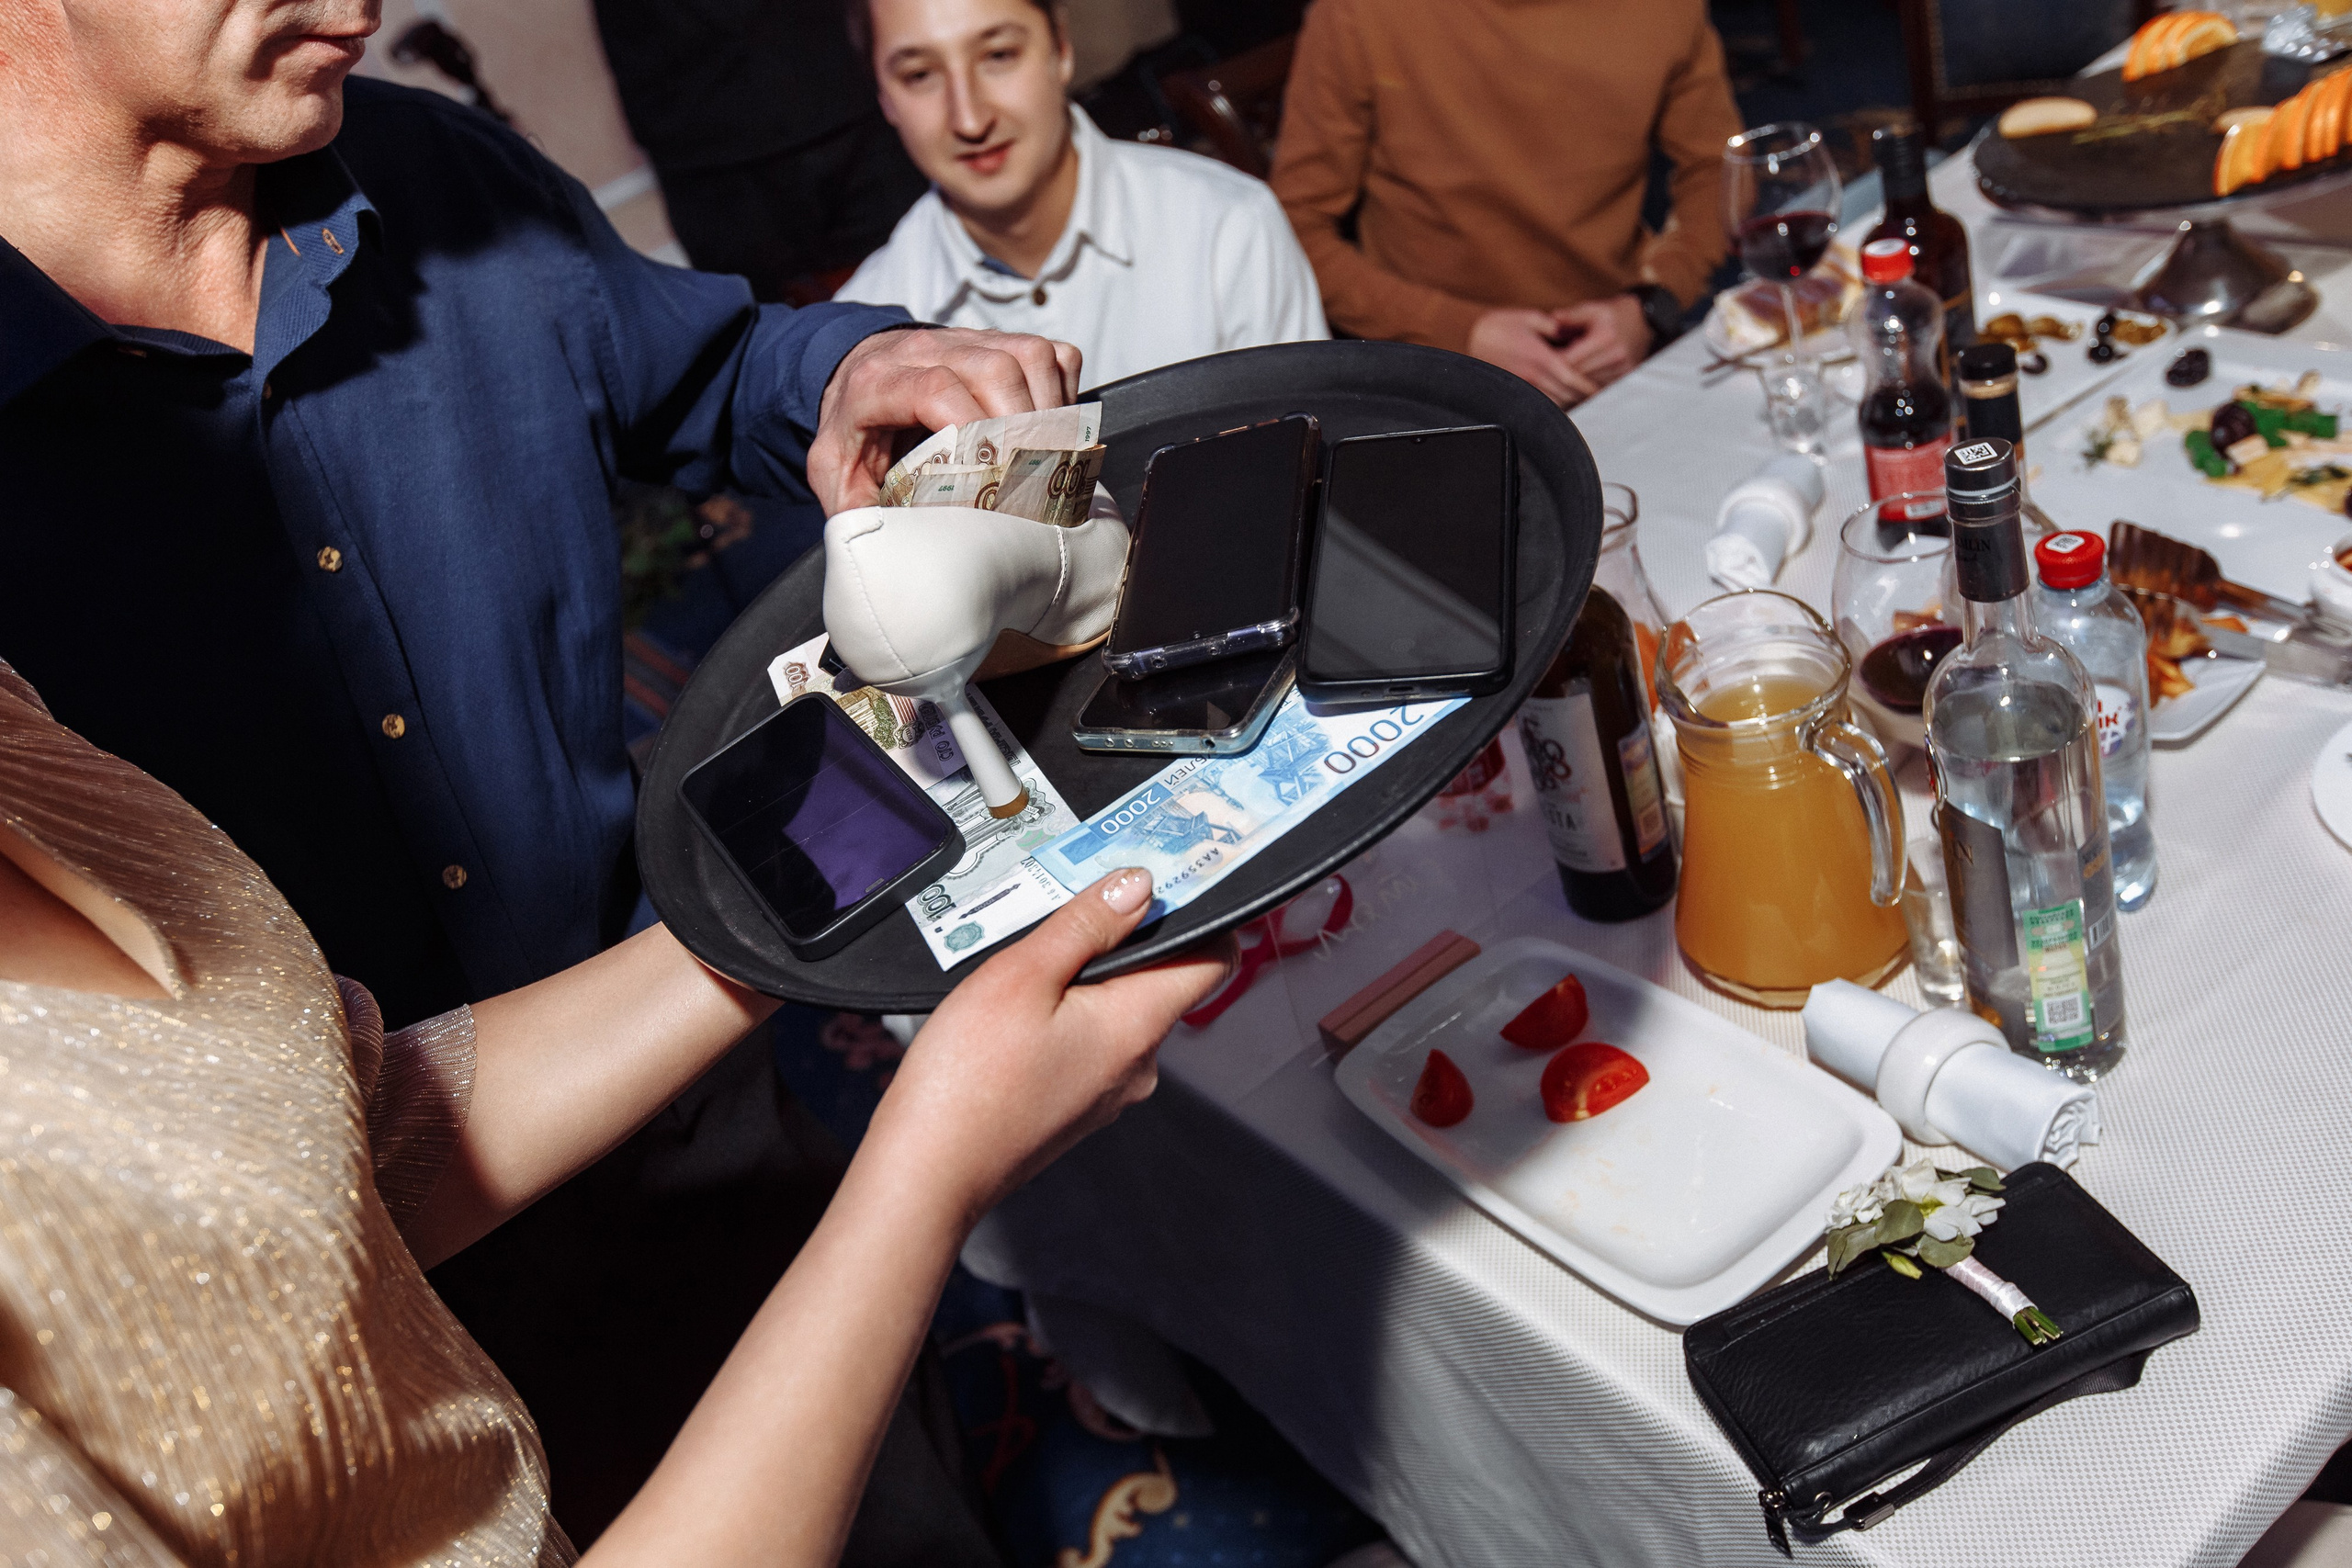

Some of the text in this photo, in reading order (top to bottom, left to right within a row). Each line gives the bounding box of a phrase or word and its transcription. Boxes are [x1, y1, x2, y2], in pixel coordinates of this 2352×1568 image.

[786, 665, 805, 689] 100
[934, 740, 955, 762] СТО
[1324, 705, 1424, 774] 2000
[1164, 754, 1211, 786] БЛЕЙ
[1100, 788, 1161, 835] 2000
[917, 885, 956, 924] 100
